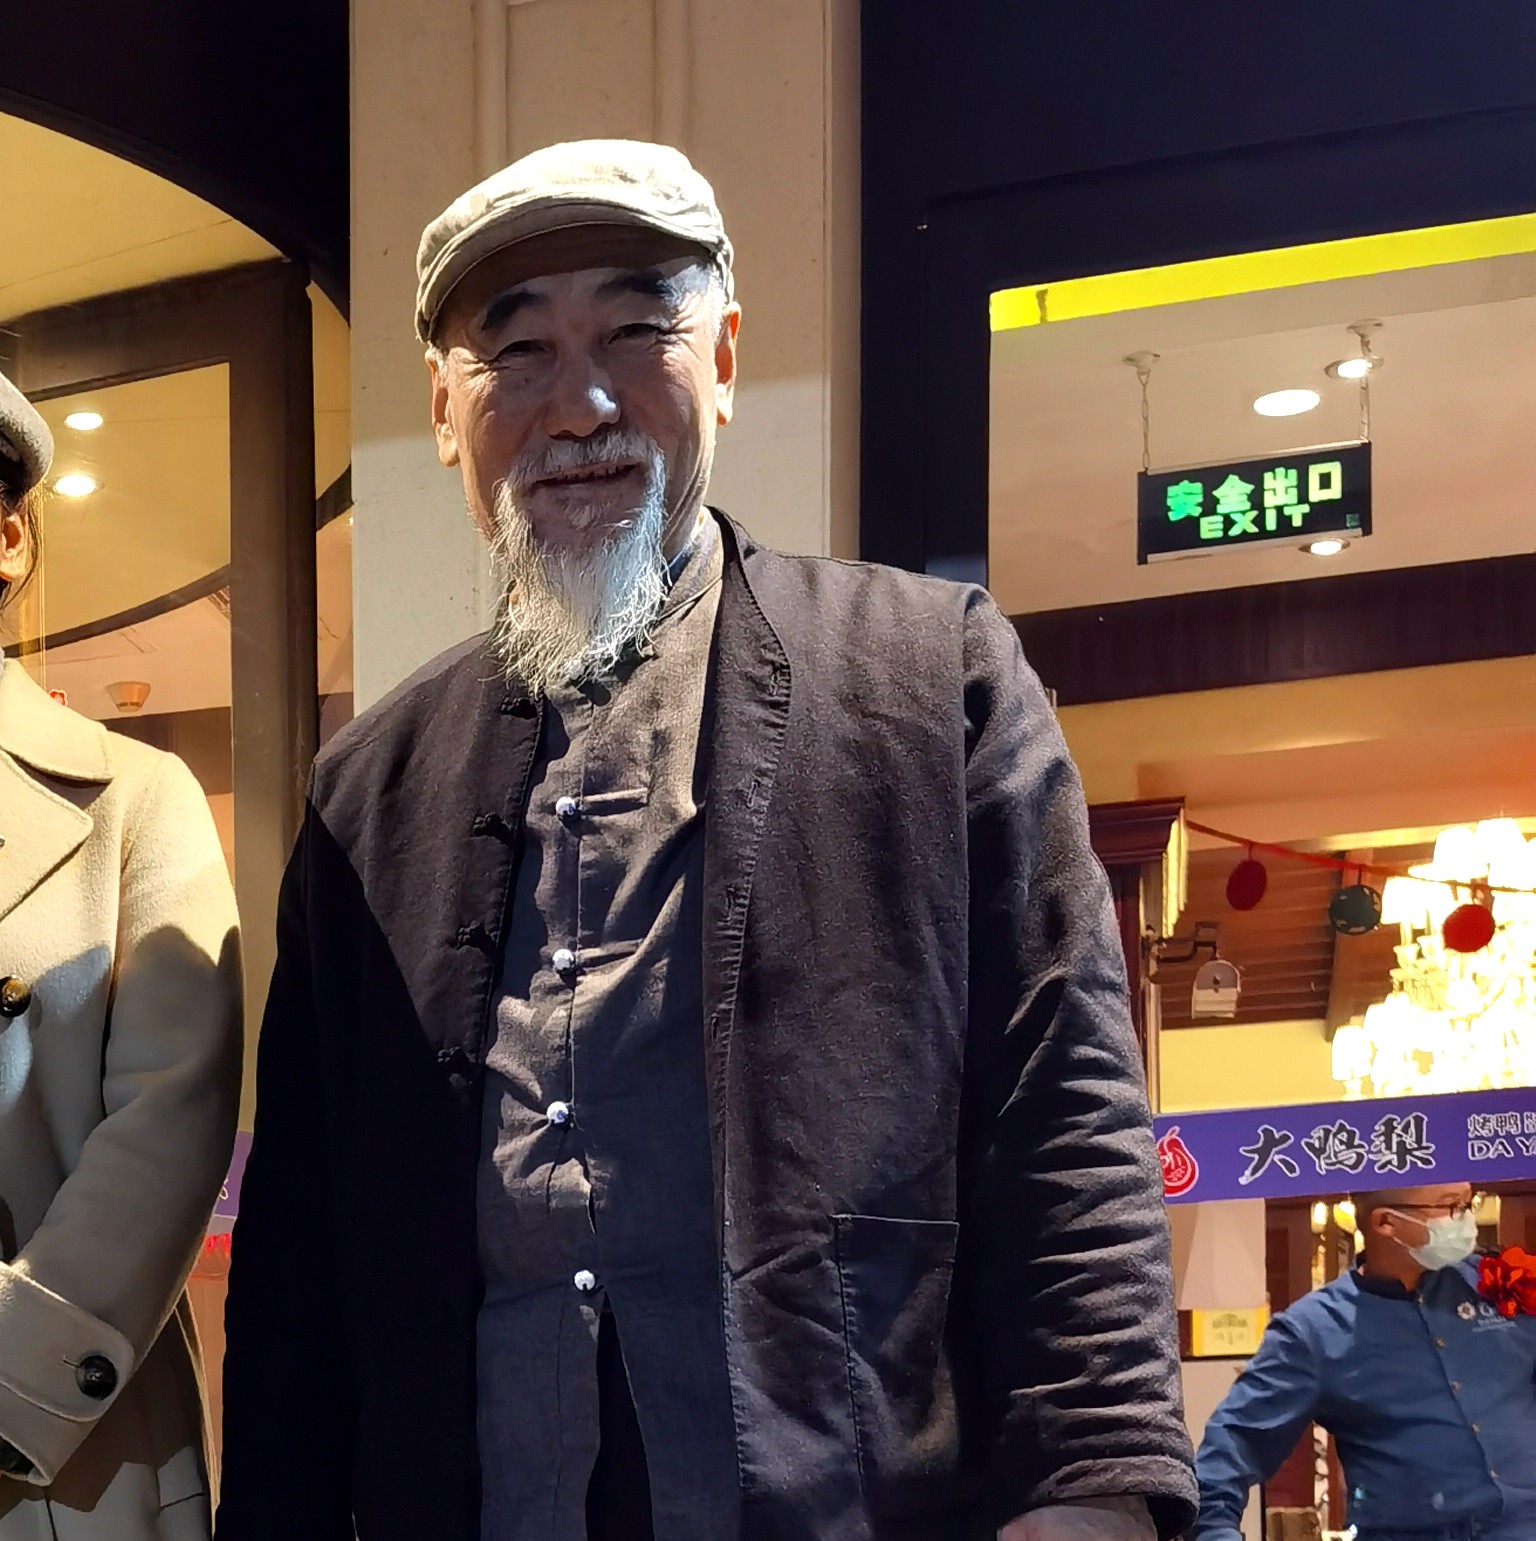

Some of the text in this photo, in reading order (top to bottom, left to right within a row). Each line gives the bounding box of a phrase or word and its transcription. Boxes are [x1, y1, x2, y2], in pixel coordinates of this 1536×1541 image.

[1167, 461, 1342, 521] 安全出口
[1200, 504, 1310, 539] EXIT
[1468, 1138, 1514, 1161] DA
